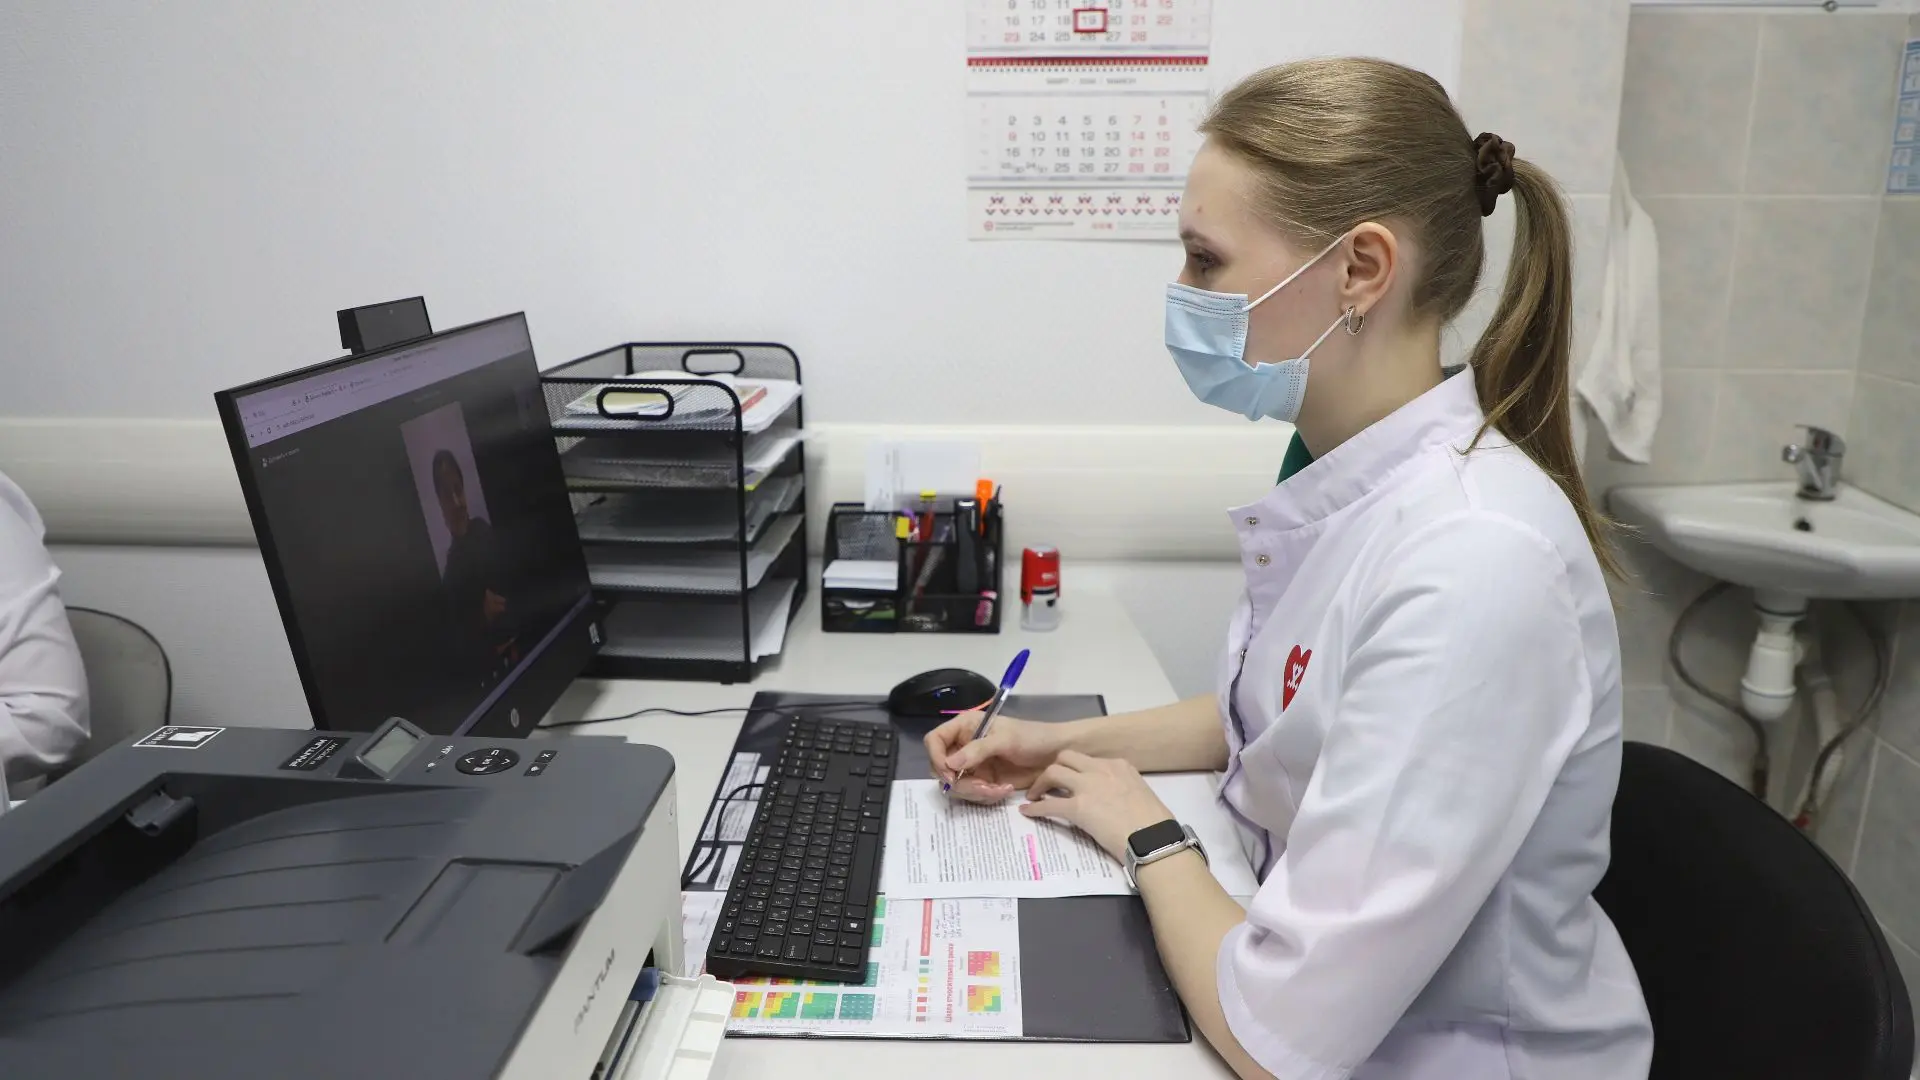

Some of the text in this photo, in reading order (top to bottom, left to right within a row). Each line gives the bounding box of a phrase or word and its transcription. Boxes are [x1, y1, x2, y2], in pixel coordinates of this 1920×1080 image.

[1031, 0, 1046, 9] 10
[1057, 0, 1070, 9] 11
[1005, 16, 1020, 25] 16
[1031, 16, 1045, 25] 17
[1056, 16, 1071, 25] 18
[1081, 16, 1097, 25] 19
[1131, 16, 1146, 25] 21
[1157, 16, 1173, 25] 22
[1004, 32, 1020, 42] 23
[1029, 32, 1046, 42] 24
[1054, 32, 1071, 42] 25
[1105, 32, 1121, 42] 27
[1131, 32, 1147, 42] 28
[1008, 115, 1167, 126] 2 3 4 5 6 7 8
[1029, 132, 1046, 141] 10
[1056, 132, 1070, 141] 11
[1081, 132, 1095, 141] 12
[1105, 132, 1120, 141] 13
[1131, 132, 1146, 141] 14
[1156, 132, 1171, 141] 15
[1006, 147, 1170, 157] 16 17 18 19 20 21 22
[1054, 163, 1070, 173] 25
[1079, 163, 1095, 173] 26
[1104, 163, 1119, 173] 27
[289, 739, 328, 767] PANTUM
